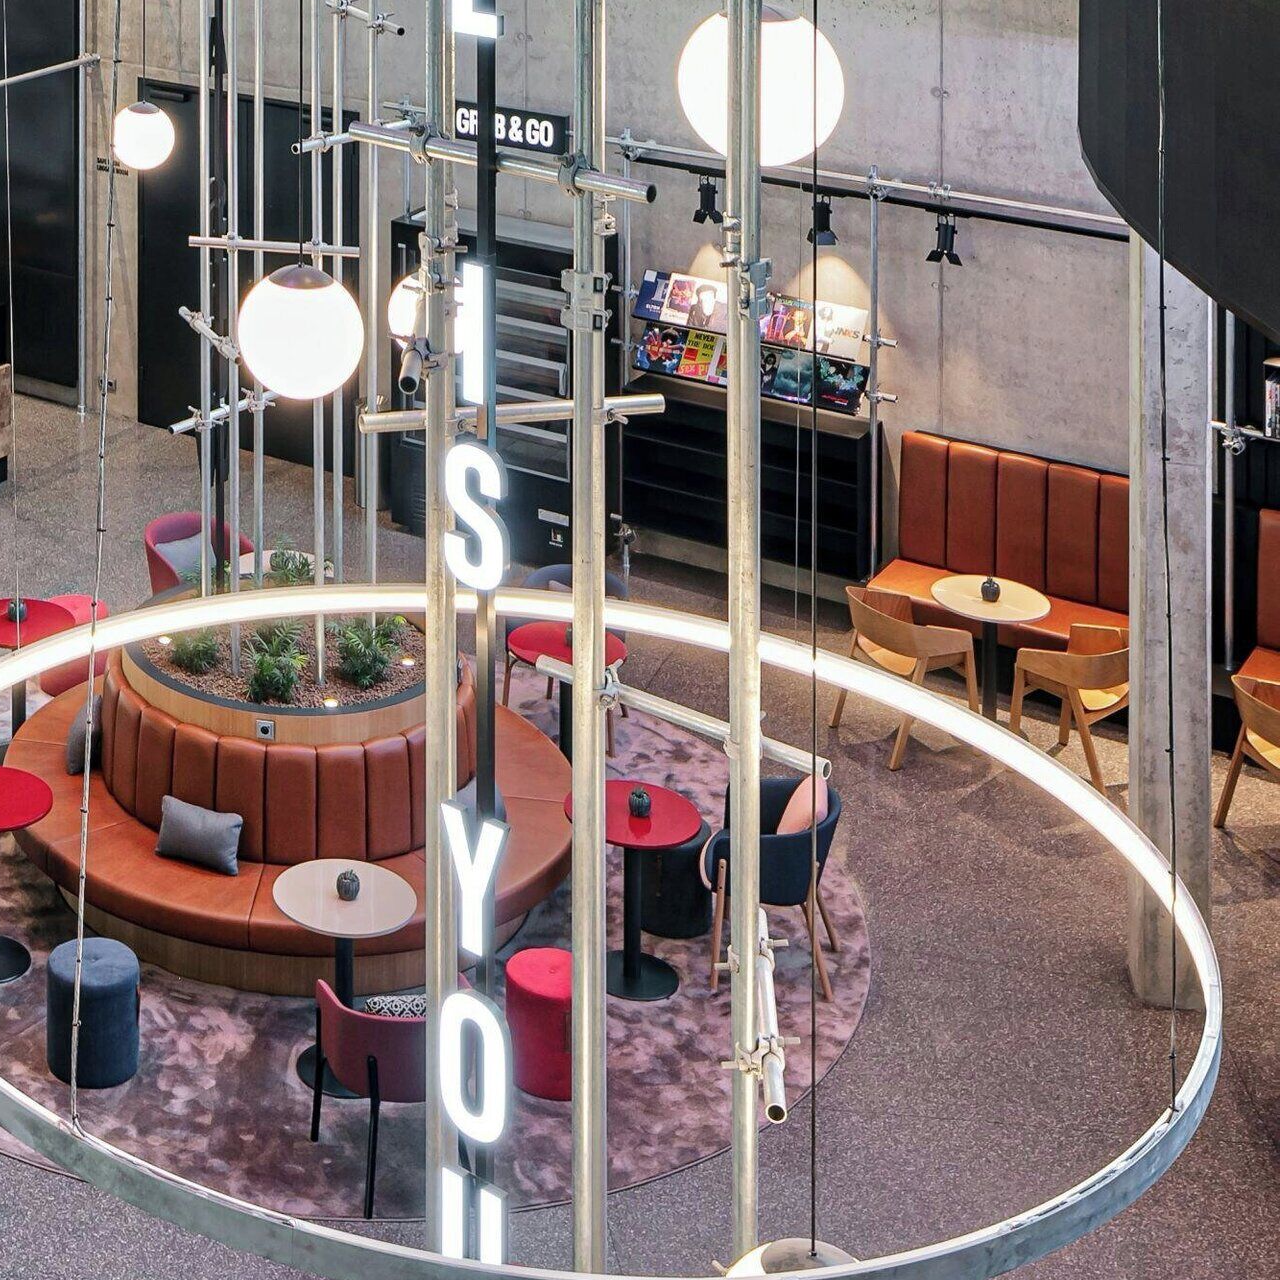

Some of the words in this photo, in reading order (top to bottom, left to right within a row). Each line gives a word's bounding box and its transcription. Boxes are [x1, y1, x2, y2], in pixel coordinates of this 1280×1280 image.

[456, 107, 506, 139] GRB
[508, 115, 523, 143] &
[525, 118, 555, 147] GO
[444, 261, 509, 591] IS
